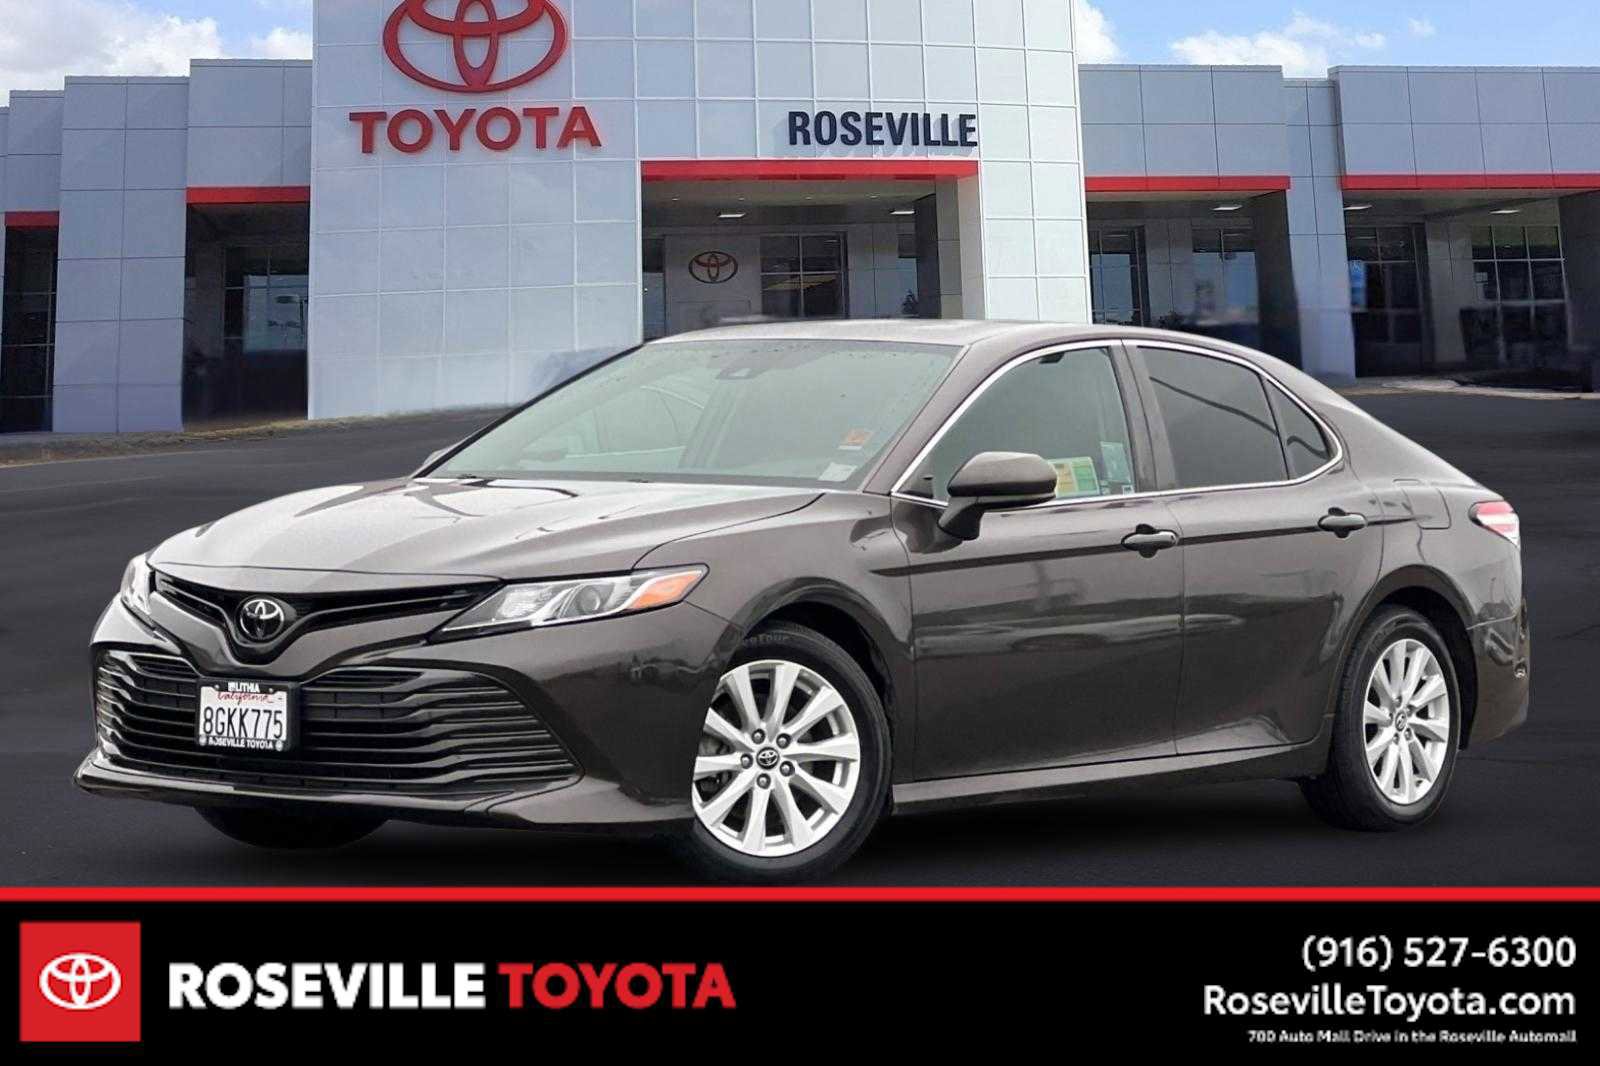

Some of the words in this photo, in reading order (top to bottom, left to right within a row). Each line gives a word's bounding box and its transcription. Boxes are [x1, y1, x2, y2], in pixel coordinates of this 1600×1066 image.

[349, 106, 602, 154] TOYOTA
[788, 110, 978, 147] ROSEVILLE
[217, 692, 273, 706] California
[203, 706, 283, 739] 8GKK775
[208, 737, 245, 748] ROSEVILLE
[247, 740, 273, 749] TOYOTA
